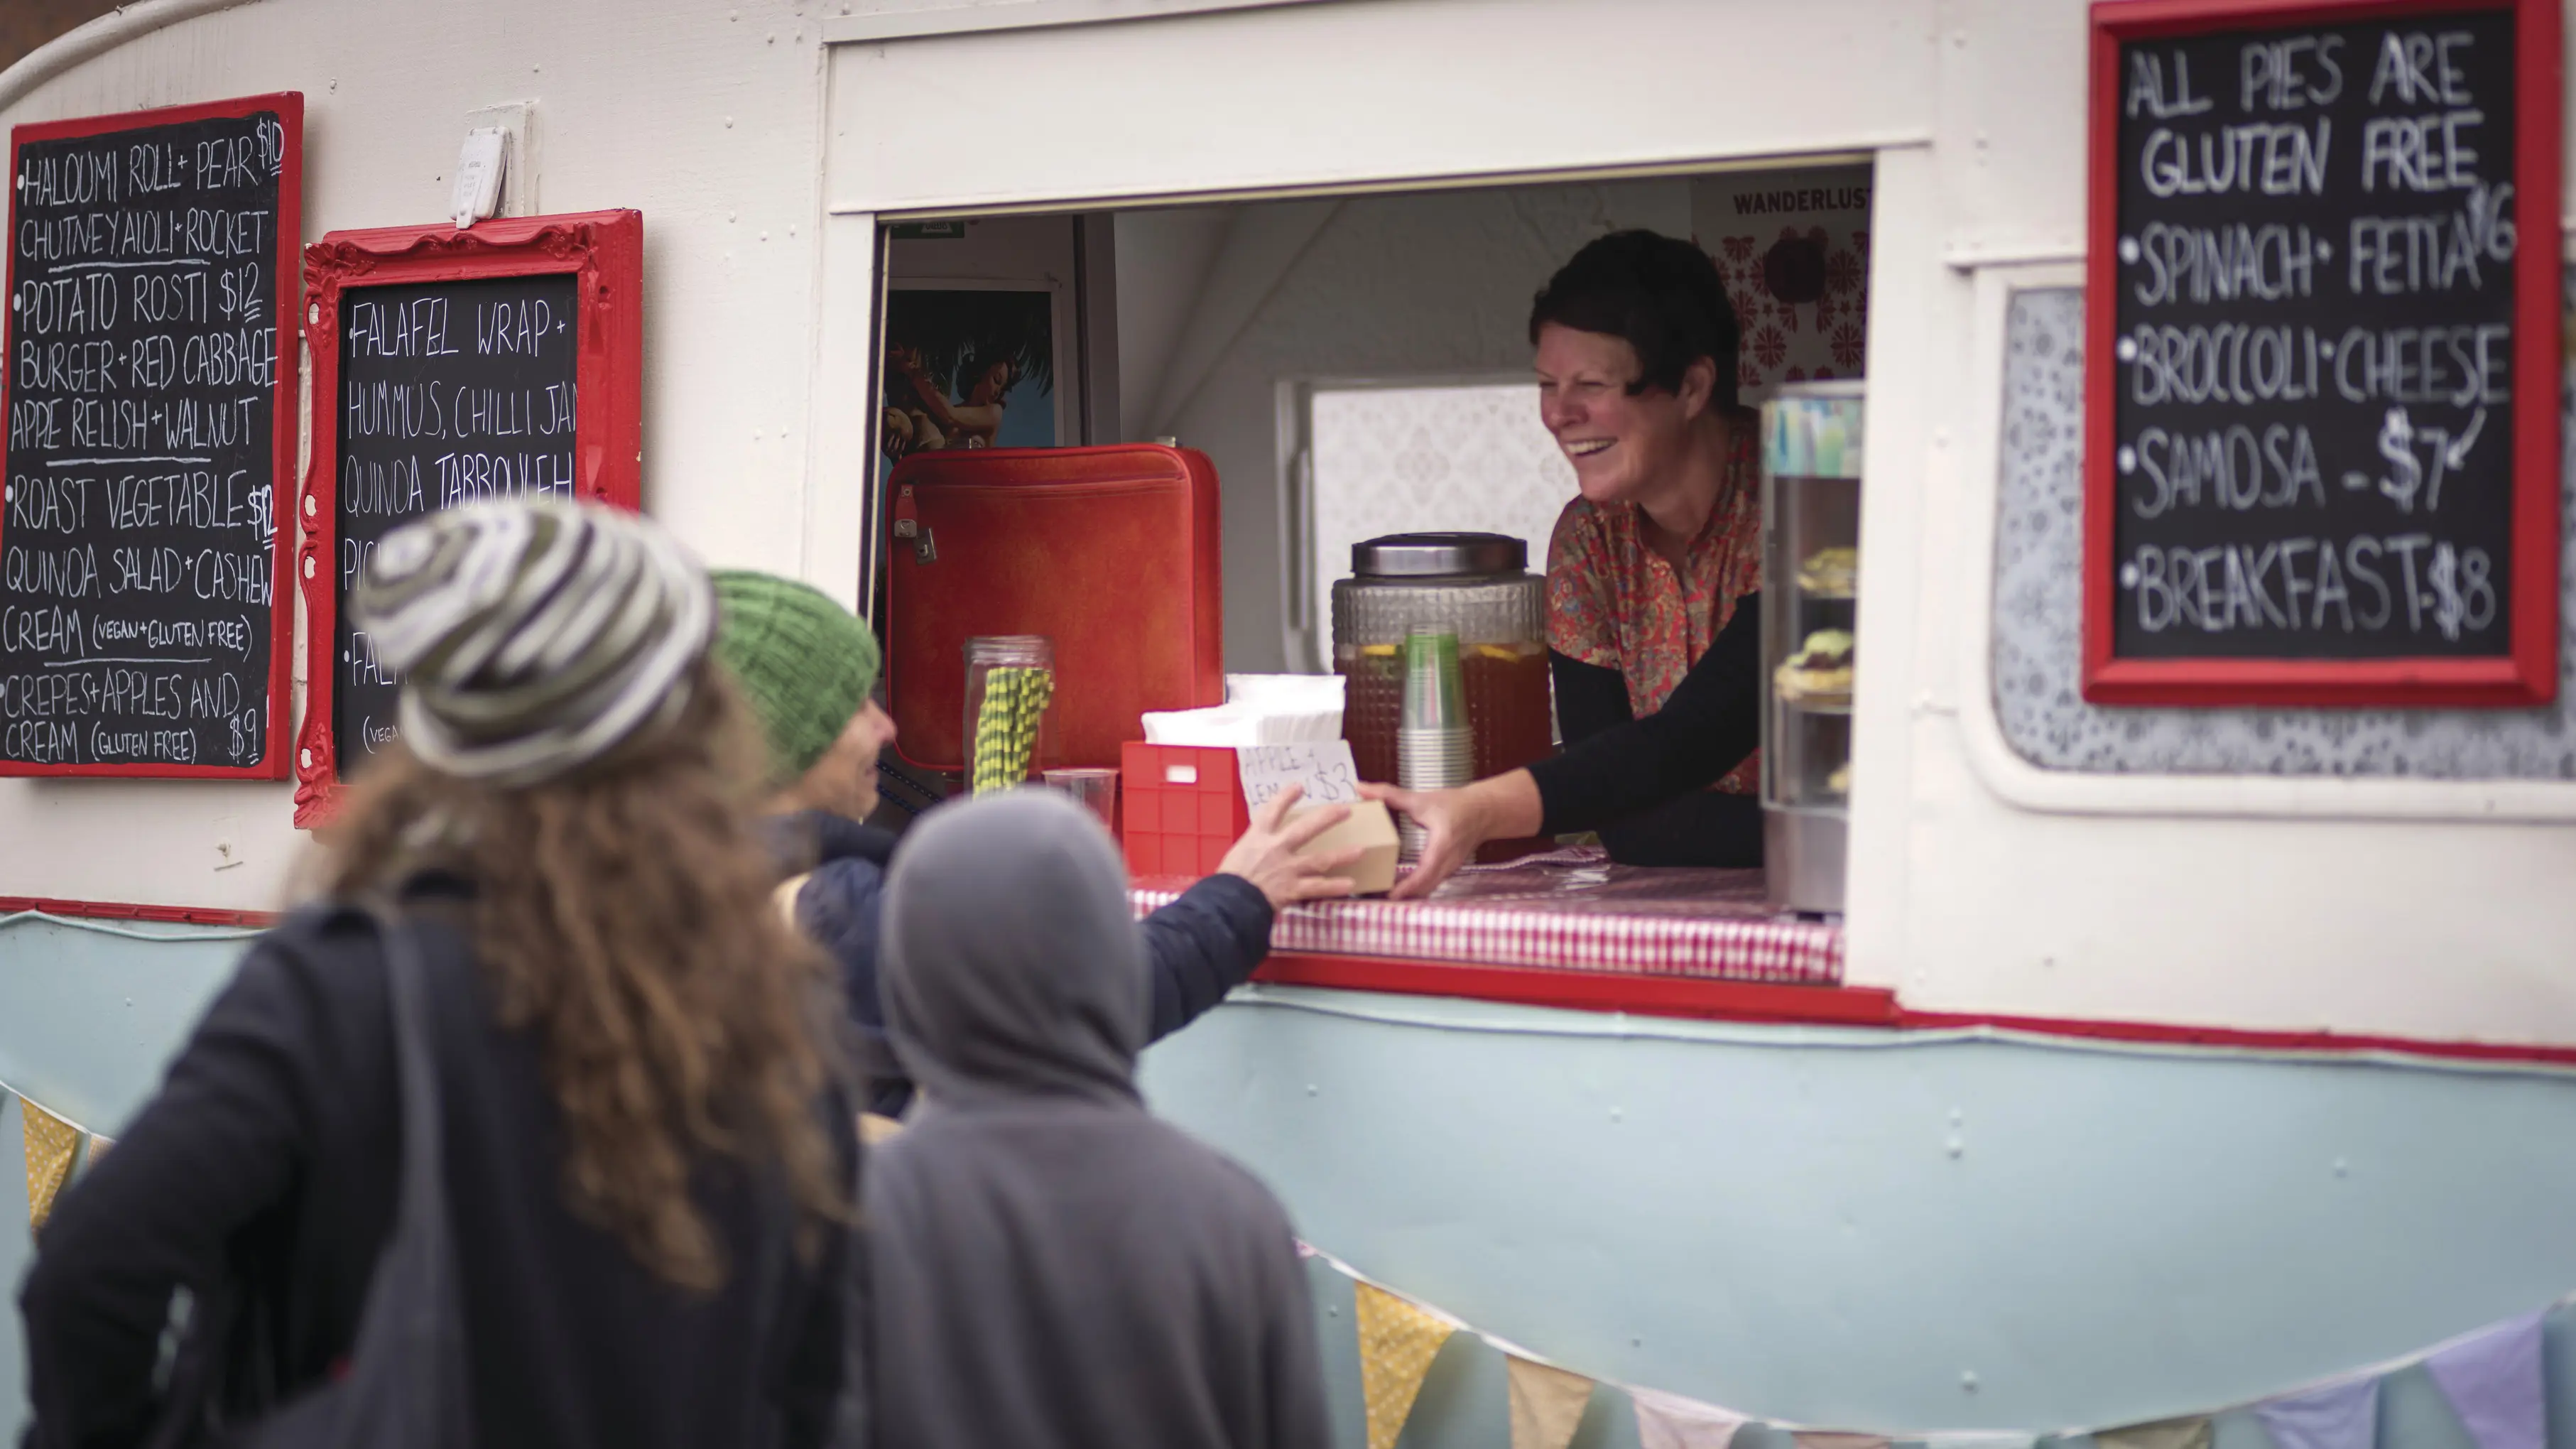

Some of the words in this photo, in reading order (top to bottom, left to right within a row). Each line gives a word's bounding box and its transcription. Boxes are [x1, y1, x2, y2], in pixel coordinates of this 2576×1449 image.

[2127, 48, 2213, 119] ALL
[2241, 33, 2344, 111] PIES
[2369, 31, 2474, 106] ARE
[24, 151, 116, 207] HALOUMI
[197, 136, 259, 190] PEAR
[257, 116, 284, 169] $10
[2142, 114, 2331, 197] GLUTEN
[2362, 109, 2484, 192] FREE
[2135, 222, 2312, 306] SPINACH
[2349, 212, 2482, 293] FETTA
[23, 273, 116, 334] POTATO
[134, 273, 207, 323] ROSTI
[219, 263, 263, 321] $12
[353, 298, 460, 357] FALAFEL
[478, 300, 550, 357] WRAP
[21, 340, 116, 393] BURGER
[132, 335, 175, 389] RED
[184, 328, 278, 387] CABBAGE
[72, 398, 147, 450] RELISH
[165, 396, 258, 450] WALNUT
[455, 386, 531, 438] CHILLI
[345, 455, 424, 517] QUINOA
[2133, 423, 2325, 519] SAMOSA
[13, 474, 95, 533] ROAST
[107, 470, 246, 529] VEGETABLE
[247, 484, 278, 541] $12
[6, 543, 101, 599] QUINOA
[109, 547, 182, 593] SALAD
[195, 544, 276, 607] CASHEW
[2136, 534, 2432, 632] BREAKFAST
[4, 605, 84, 657] CREAM
[207, 614, 252, 663] FREE)
[4, 672, 92, 717] CREPES
[102, 667, 181, 720] APPLES
[190, 673, 240, 718] AND
[6, 720, 79, 764] CREAM
[91, 721, 148, 761] (GLUTEN
[154, 728, 196, 764] FREE)
[227, 708, 256, 764] $9
